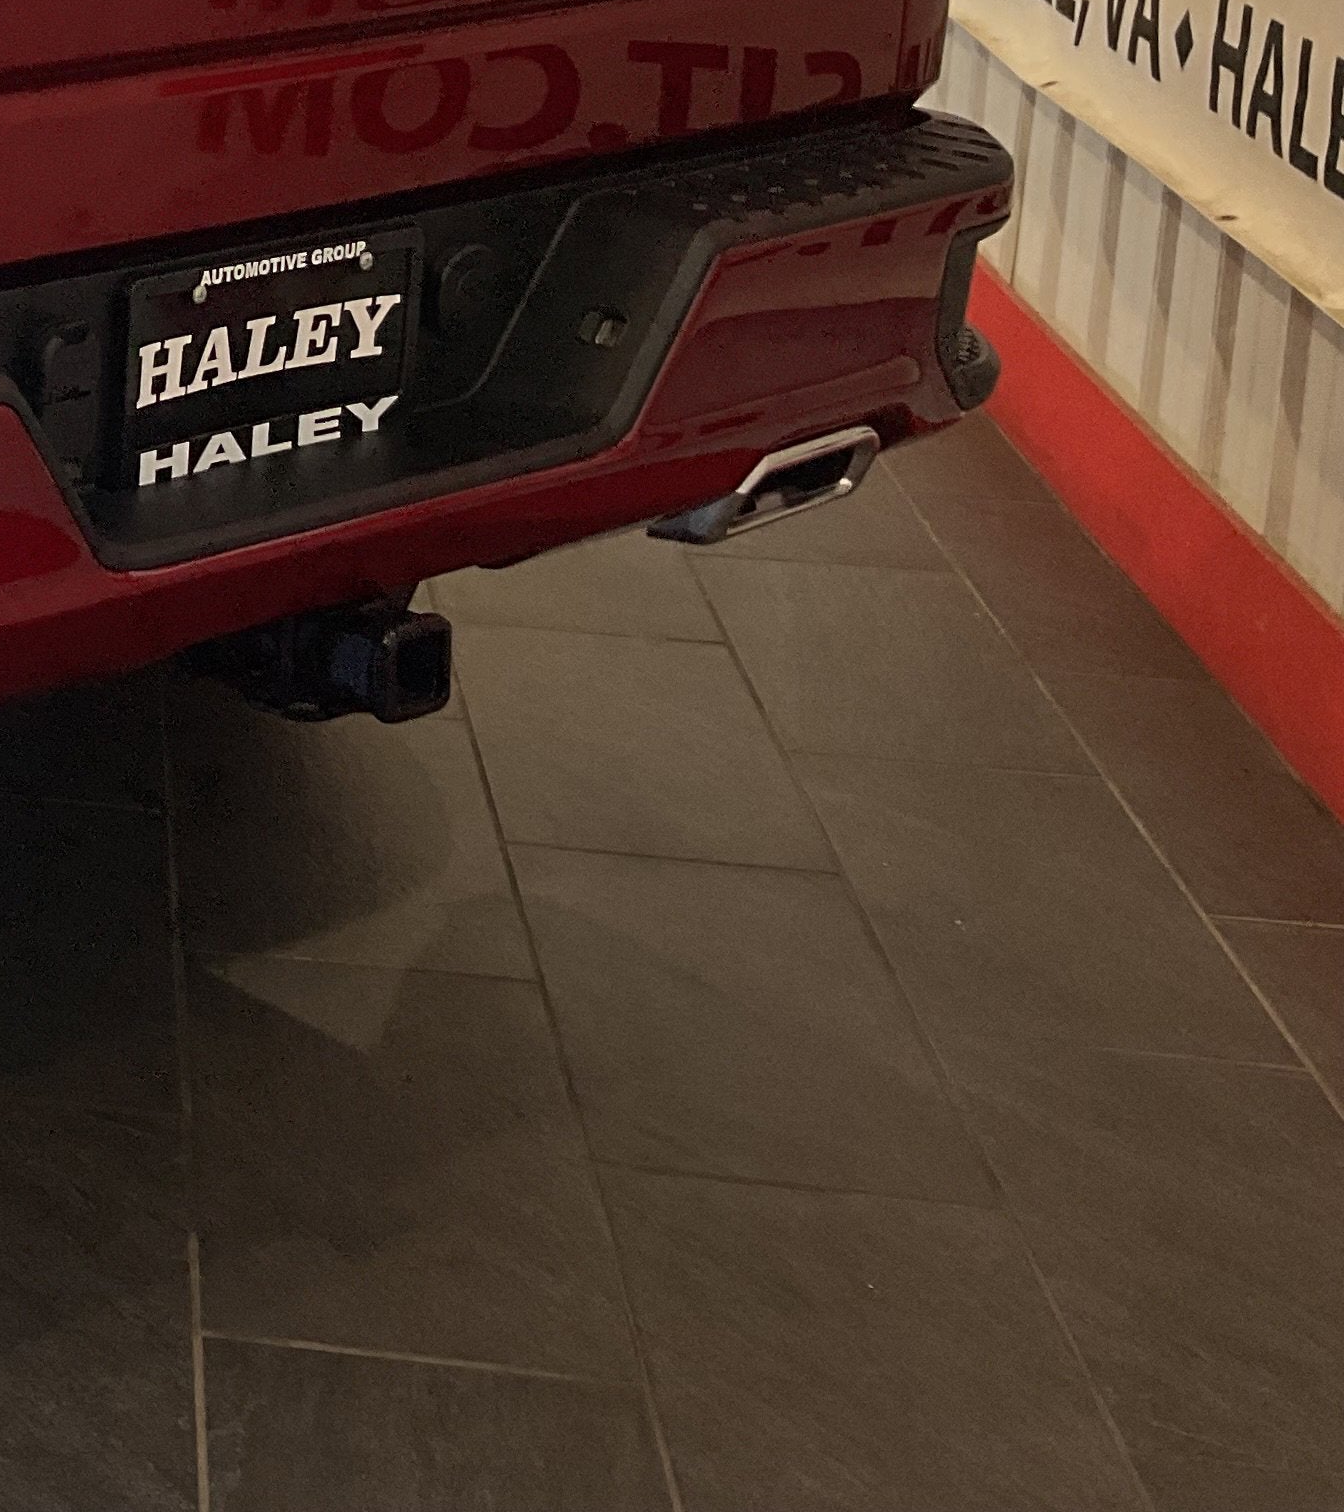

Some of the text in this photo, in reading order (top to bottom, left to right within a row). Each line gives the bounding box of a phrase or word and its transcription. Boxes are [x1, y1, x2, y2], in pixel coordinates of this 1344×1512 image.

[200, 240, 367, 288] AUTOMOTIVE GROUP
[135, 293, 402, 410] HALEY
[137, 394, 400, 487] HALEY
